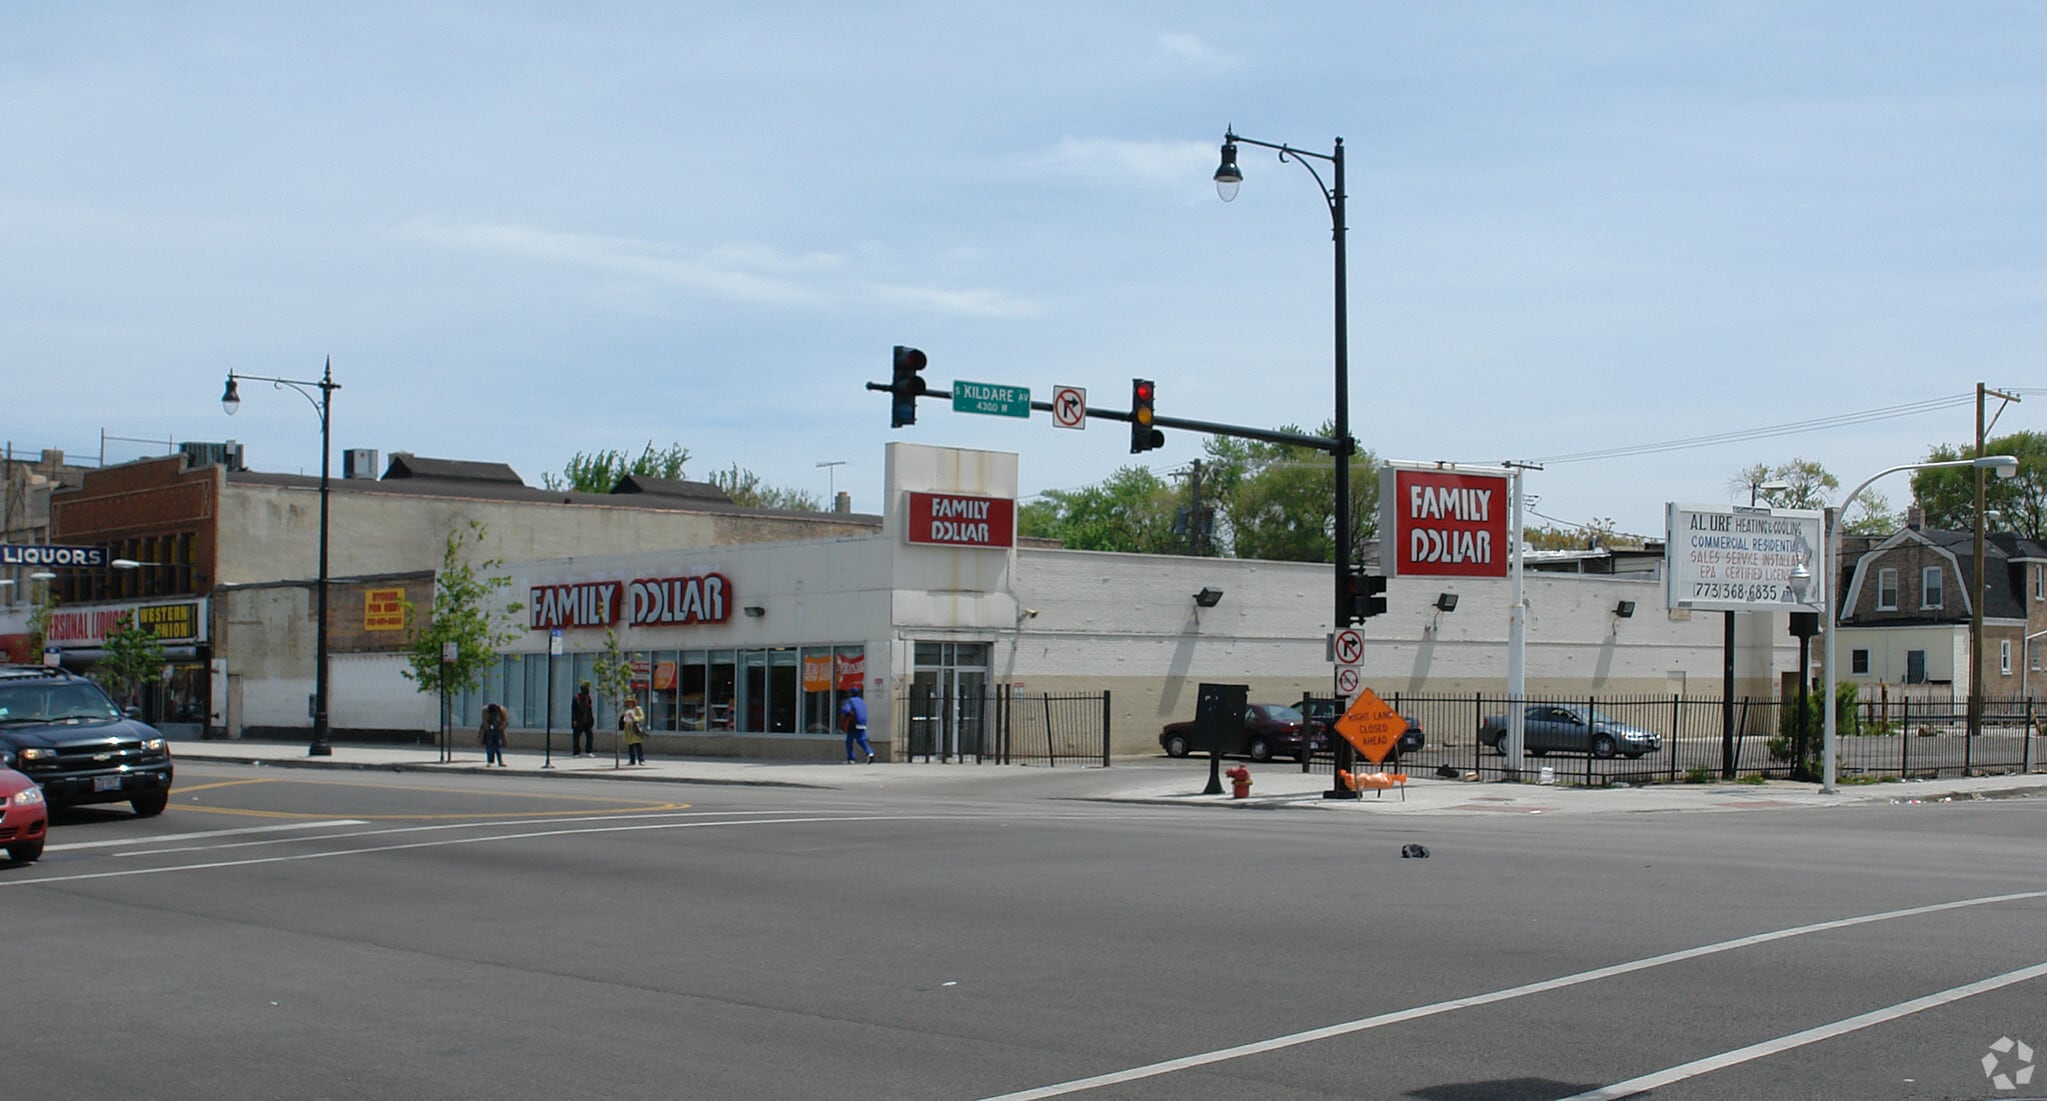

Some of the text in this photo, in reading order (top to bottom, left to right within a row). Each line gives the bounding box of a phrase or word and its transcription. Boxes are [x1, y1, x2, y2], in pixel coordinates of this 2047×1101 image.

[955, 385, 1029, 402] S KILDARE AV
[976, 401, 1008, 413] 4300 W
[931, 497, 990, 520] FAMILY
[1410, 485, 1492, 522] FAMILY
[931, 520, 989, 543] DOLLAR
[1735, 518, 1768, 535] HEATING
[1410, 528, 1491, 564] DOLLAR
[1691, 535, 1749, 551] COMMERCIAL
[3, 548, 101, 565] LIQUORS
[1690, 551, 1720, 564] SALES
[1725, 553, 1759, 567] SERVICE
[1700, 565, 1716, 579] EPA
[1725, 566, 1763, 582] CERTIFIED
[530, 573, 731, 629] FAMILY DOLLAR
[140, 605, 188, 623] WESTERN
[48, 612, 89, 641] ERSONAL
[1348, 714, 1369, 722] RIGHT
[1359, 724, 1388, 734] CLOSED
[1362, 735, 1387, 745] AHEAD
